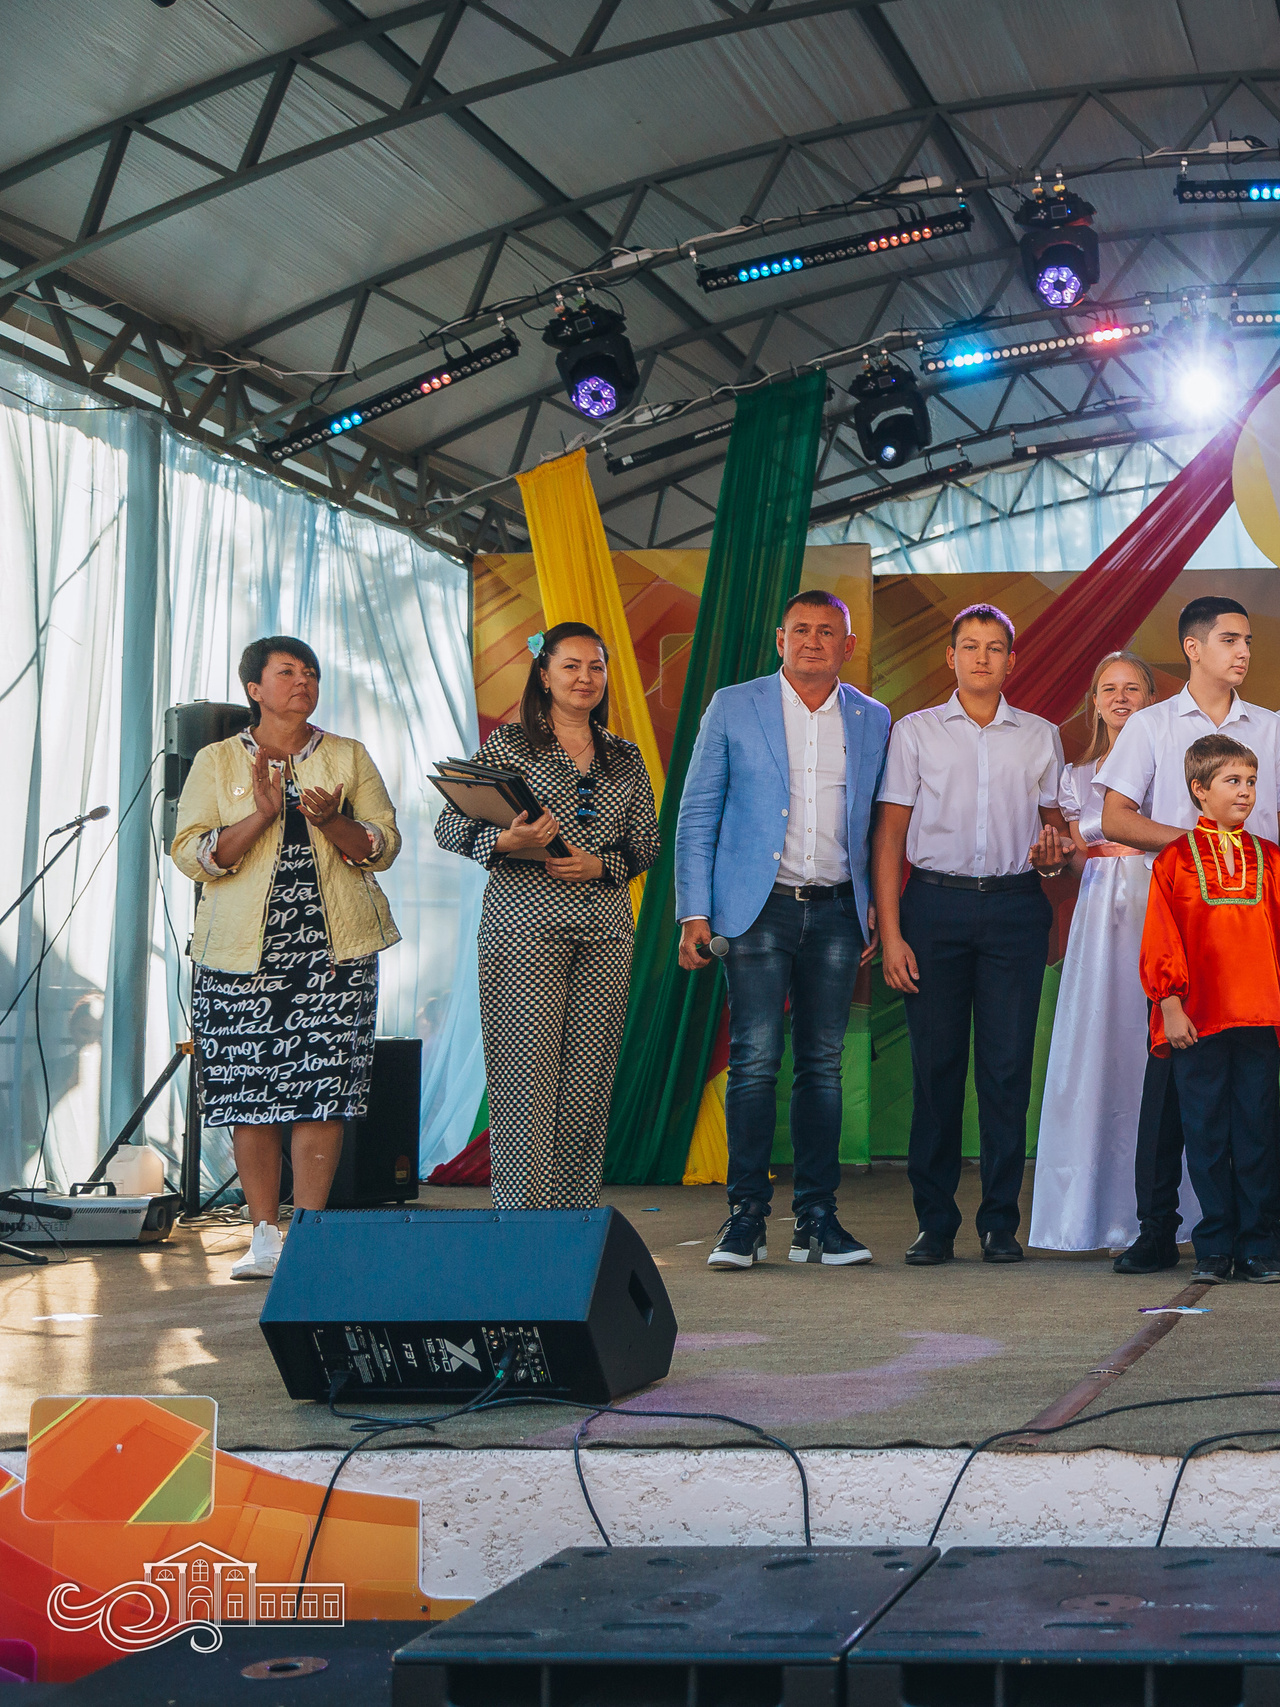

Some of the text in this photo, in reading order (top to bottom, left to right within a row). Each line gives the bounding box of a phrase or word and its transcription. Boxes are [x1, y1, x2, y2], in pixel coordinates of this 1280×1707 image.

[202, 973, 292, 996] Elisabetta
[284, 1009, 353, 1031] Cruise
[208, 1103, 302, 1126] Elisabetta
[435, 1338, 452, 1372] PRO
